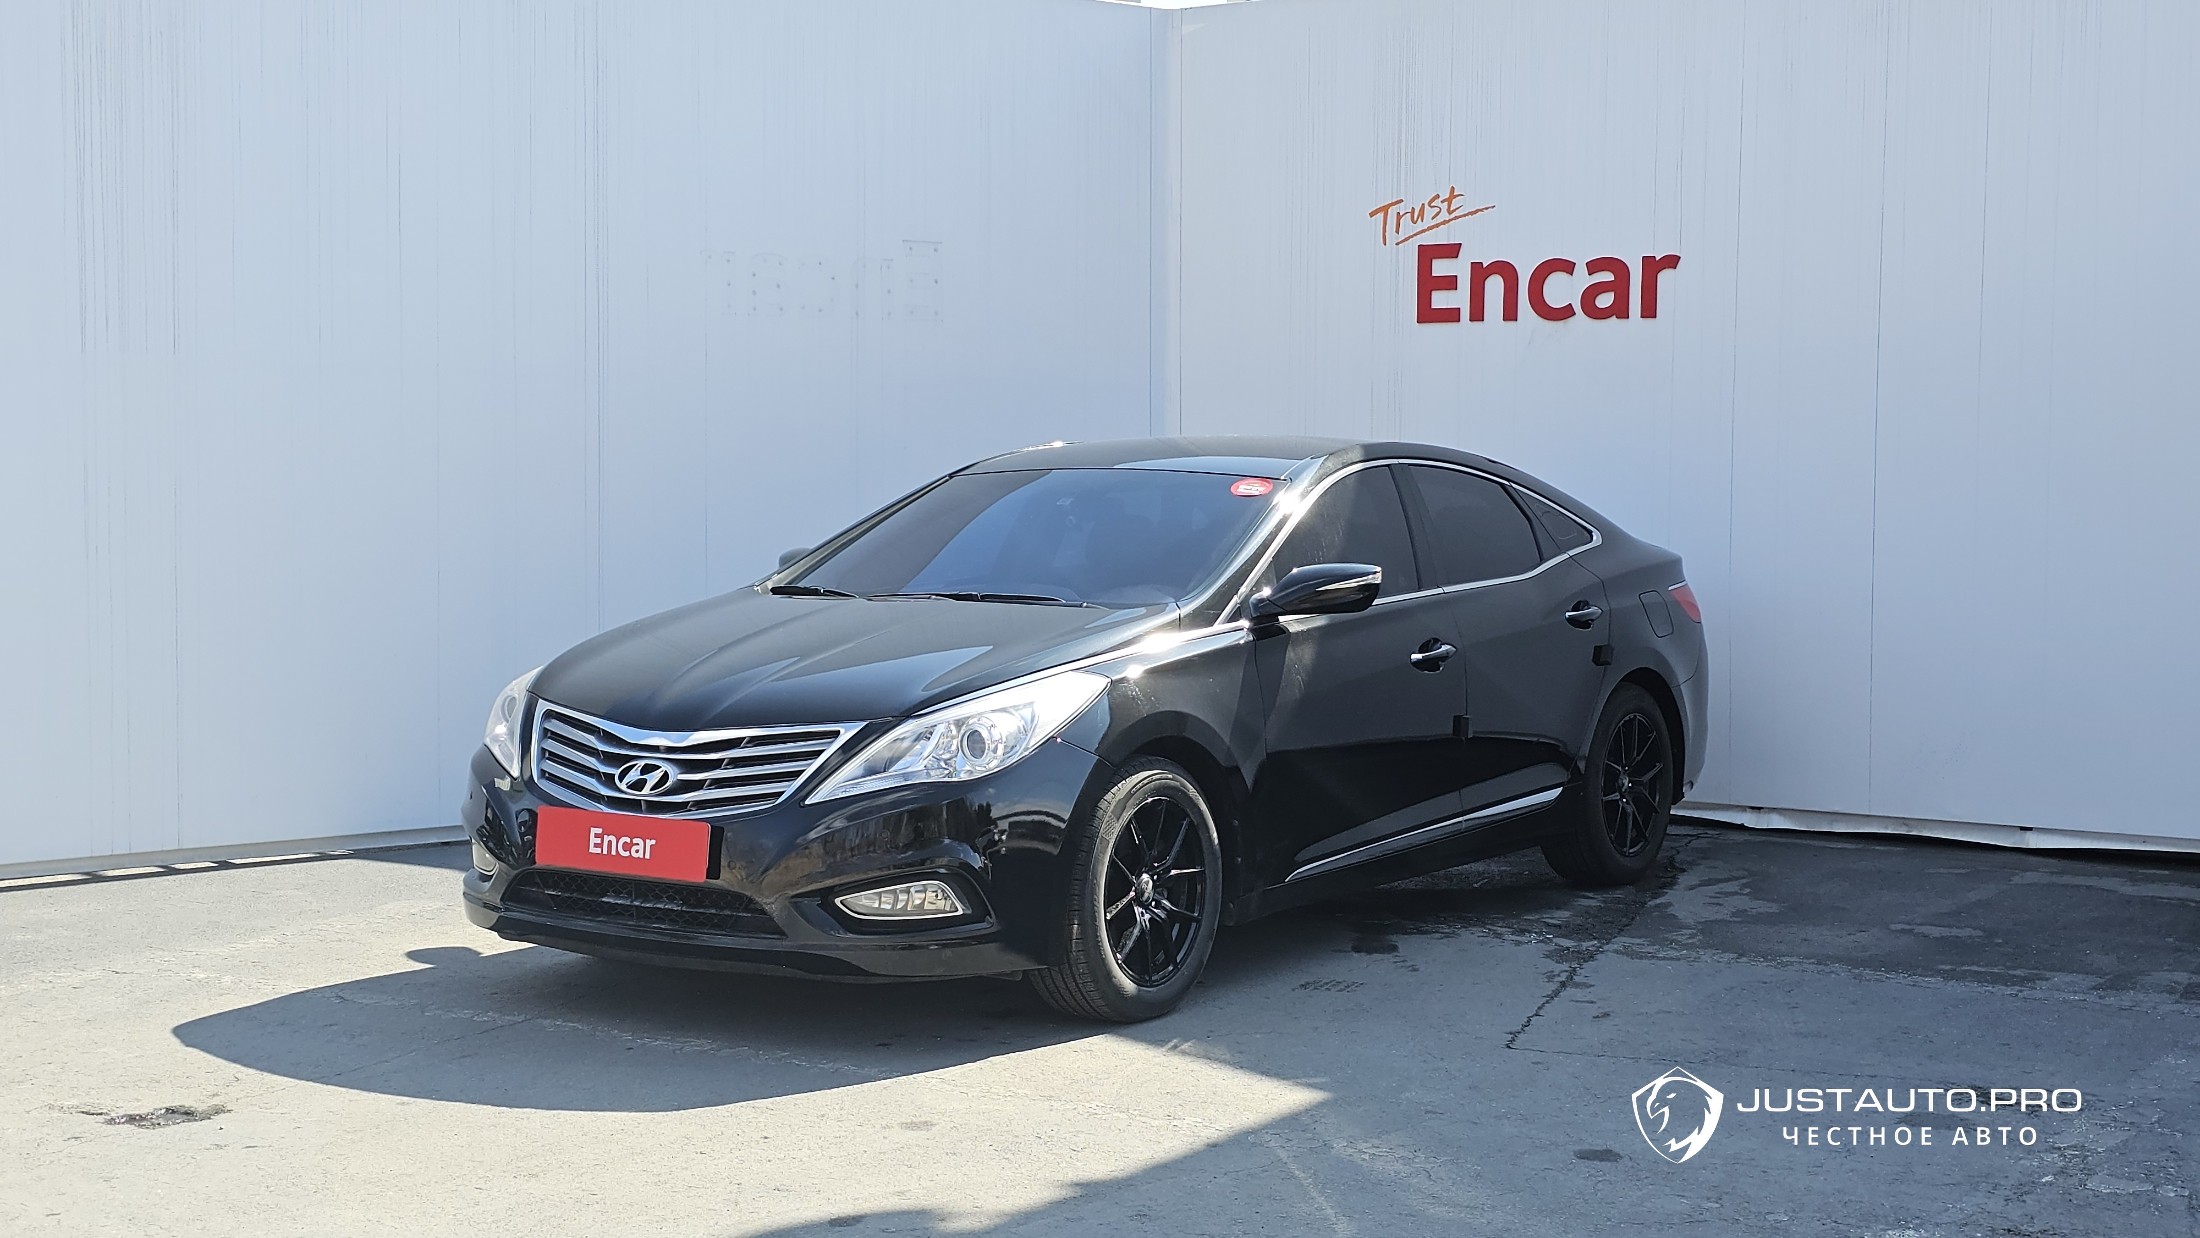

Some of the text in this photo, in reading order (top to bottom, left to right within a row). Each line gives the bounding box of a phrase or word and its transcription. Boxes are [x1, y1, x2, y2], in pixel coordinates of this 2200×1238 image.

[1368, 185, 1465, 246] Trust
[1416, 242, 1681, 324] Encar
[588, 827, 656, 860] Encar
